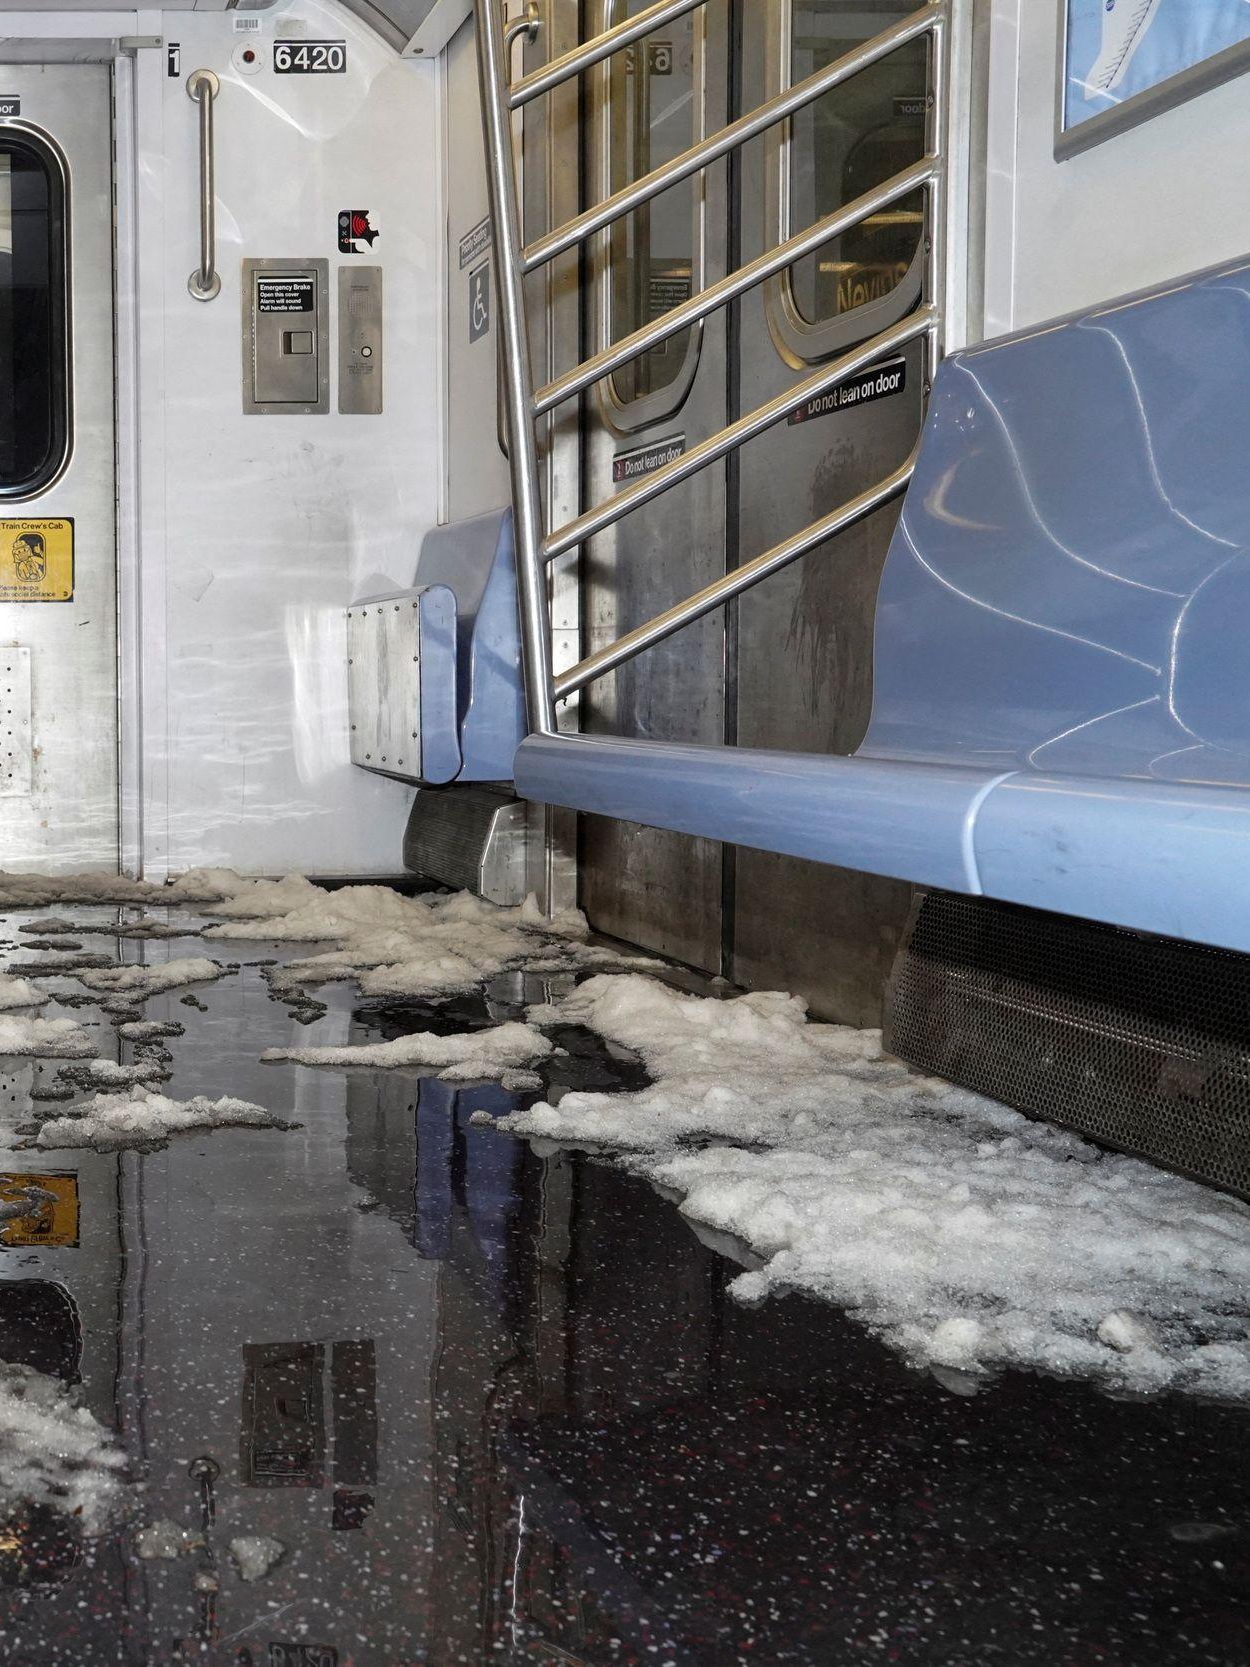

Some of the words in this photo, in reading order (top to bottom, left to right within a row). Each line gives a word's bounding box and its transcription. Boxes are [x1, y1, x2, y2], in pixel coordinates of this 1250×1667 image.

[275, 46, 344, 70] 6420
[260, 284, 293, 292] Emergency
[822, 391, 838, 410] not
[839, 386, 860, 404] lean
[861, 381, 875, 398] on
[875, 373, 901, 394] door
[625, 461, 634, 475] Do
[634, 458, 644, 472] not
[645, 454, 658, 469] lean
[658, 453, 667, 465] on
[667, 447, 682, 462] door
[1, 522, 21, 530] Train
[21, 522, 47, 530] Crew's
[48, 522, 64, 530] Cab
